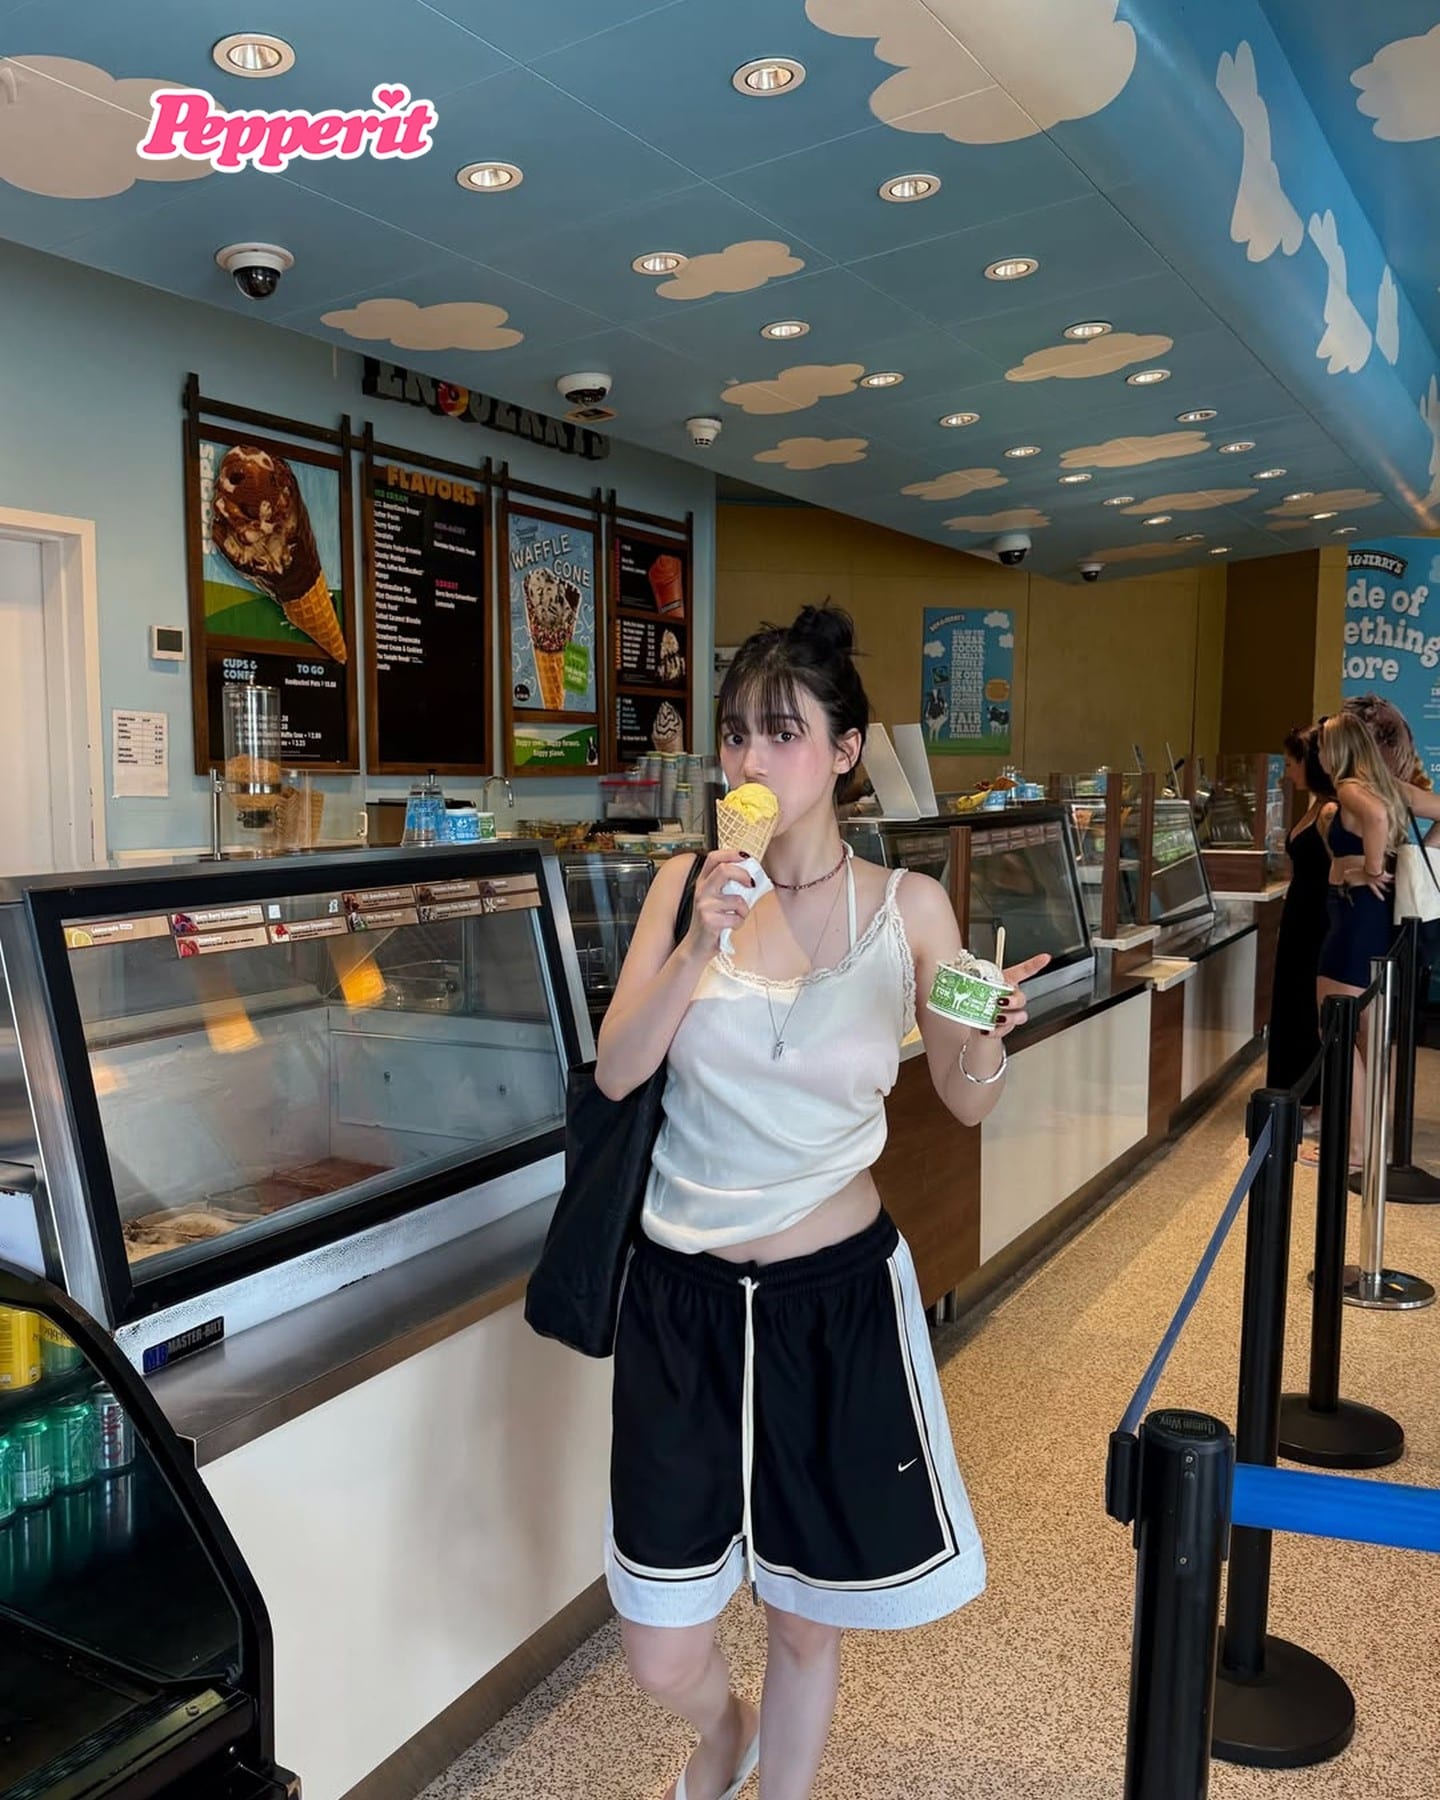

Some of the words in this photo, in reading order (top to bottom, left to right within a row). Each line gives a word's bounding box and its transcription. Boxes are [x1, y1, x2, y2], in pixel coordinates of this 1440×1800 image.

[386, 465, 476, 505] FLAVORS
[511, 533, 573, 571] WAFFLE
[553, 559, 591, 588] CONE
[1345, 578, 1385, 609] de
[1392, 585, 1429, 616] of
[223, 658, 249, 669] CUPS
[296, 664, 310, 674] TO
[310, 665, 324, 676] GO
[1342, 649, 1399, 682] ore
[950, 712, 982, 724] FAIR
[950, 724, 982, 733] TRADE
